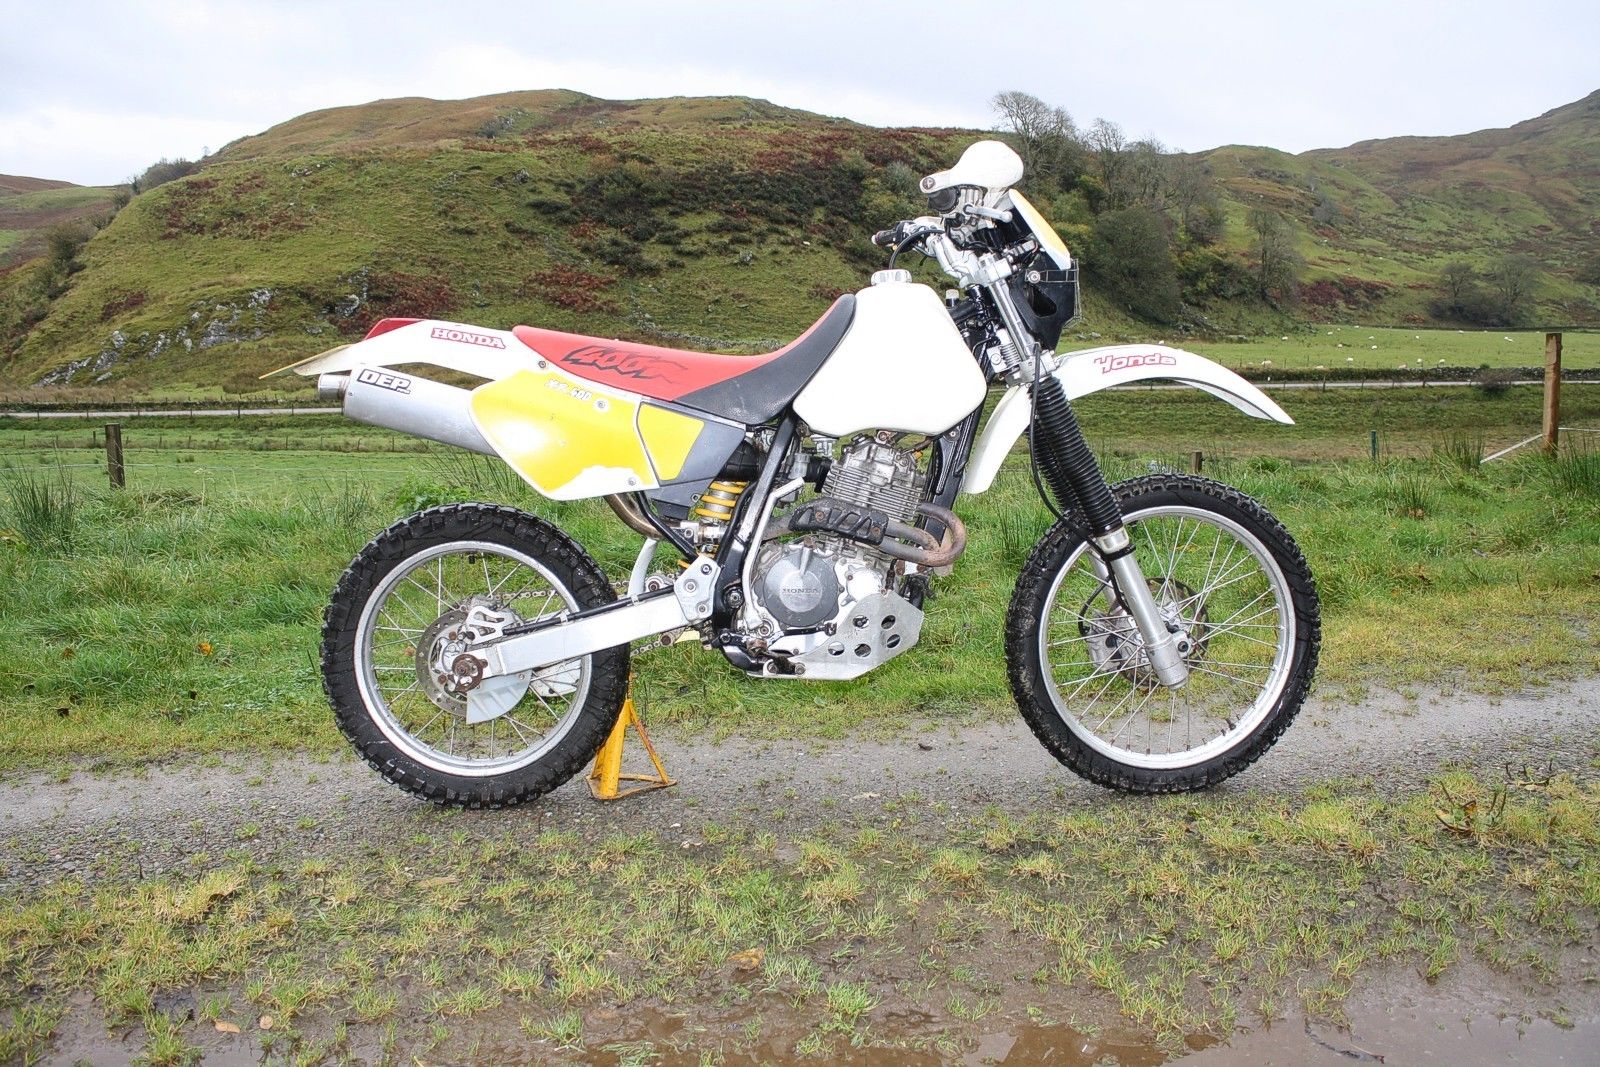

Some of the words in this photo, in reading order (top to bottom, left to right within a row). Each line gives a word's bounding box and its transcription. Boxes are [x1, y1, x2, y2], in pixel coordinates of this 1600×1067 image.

[431, 328, 506, 349] HONDA
[1094, 353, 1176, 374] Honda
[357, 369, 411, 391] DEP
